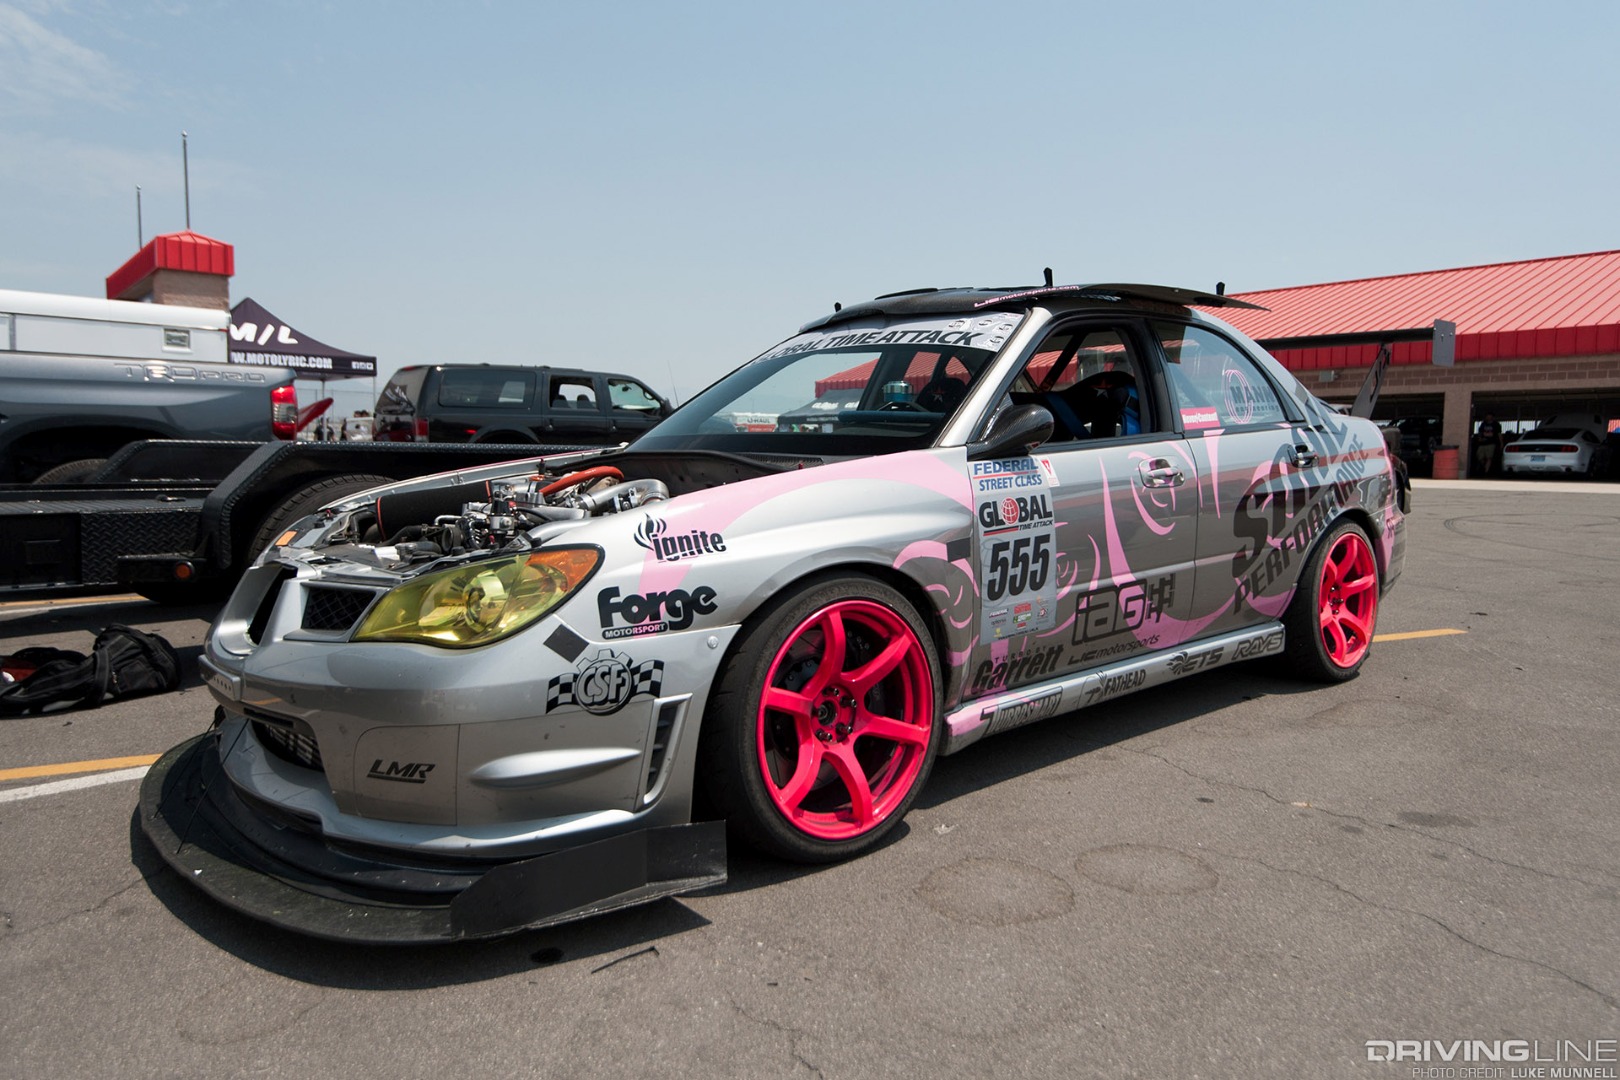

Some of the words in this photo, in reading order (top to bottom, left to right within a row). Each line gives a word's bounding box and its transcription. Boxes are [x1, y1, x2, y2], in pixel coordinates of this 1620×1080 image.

[823, 331, 883, 349] TIME
[873, 330, 983, 346] ATTACK
[231, 352, 333, 369] W.MOTOLYRIC.COM
[973, 458, 1039, 476] FEDERAL
[979, 475, 1014, 492] STREET
[1015, 474, 1043, 489] CLASS
[978, 494, 1053, 528] GLOBAL
[1018, 523, 1033, 531] TIME
[1033, 519, 1054, 528] ATTACK
[1232, 433, 1370, 616] PERFORMANCE
[652, 530, 728, 562] ignite
[987, 533, 1051, 602] 555
[604, 623, 666, 639] MOTORSPORT
[1231, 631, 1285, 662] RAYS
[582, 662, 629, 704] CSF
[971, 643, 1065, 696] Garrett
[1104, 668, 1147, 697] FATHEAD
[369, 758, 437, 779] LMR
